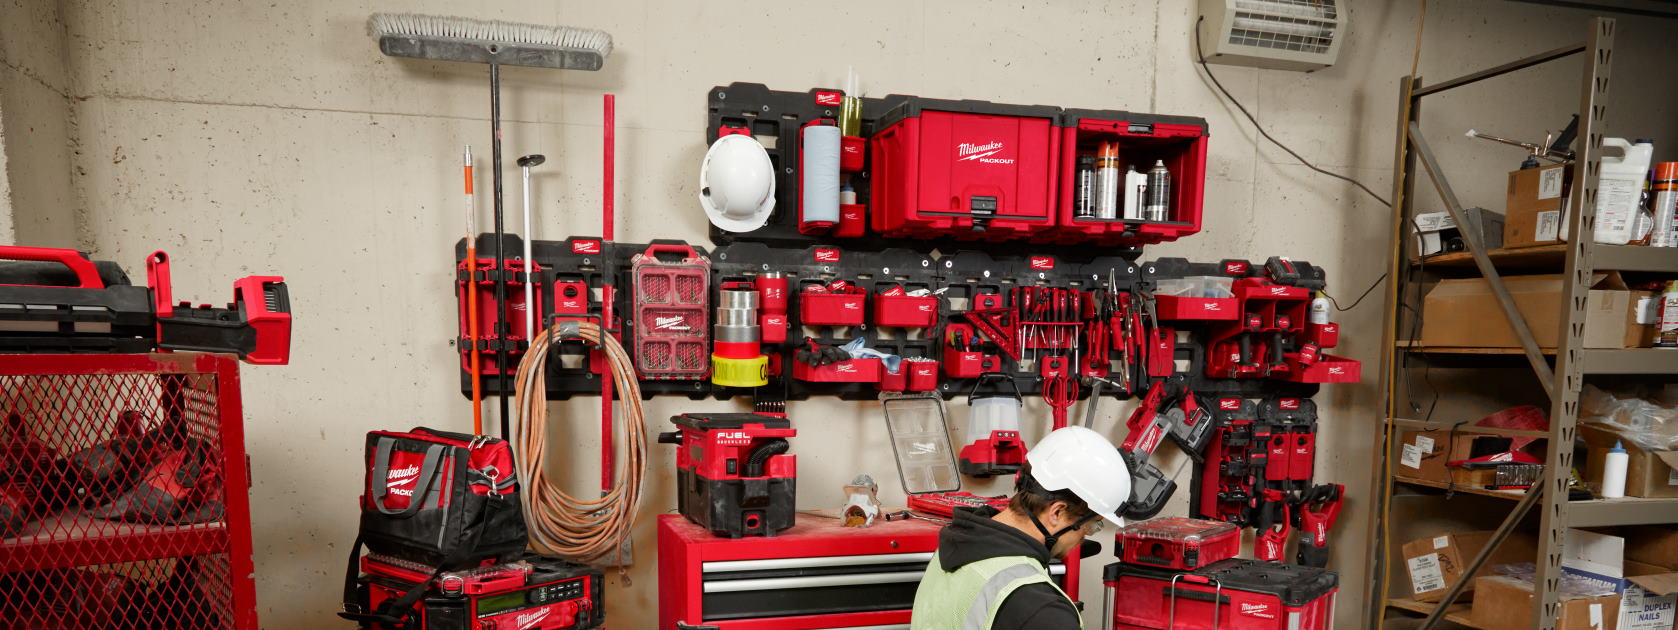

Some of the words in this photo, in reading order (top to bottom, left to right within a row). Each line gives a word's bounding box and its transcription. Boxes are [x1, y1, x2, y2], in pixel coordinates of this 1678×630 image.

[957, 141, 1003, 156] Milwaukee
[388, 464, 419, 479] waukee
[1644, 602, 1672, 613] DUPLEX
[1638, 612, 1660, 622] NAILS
